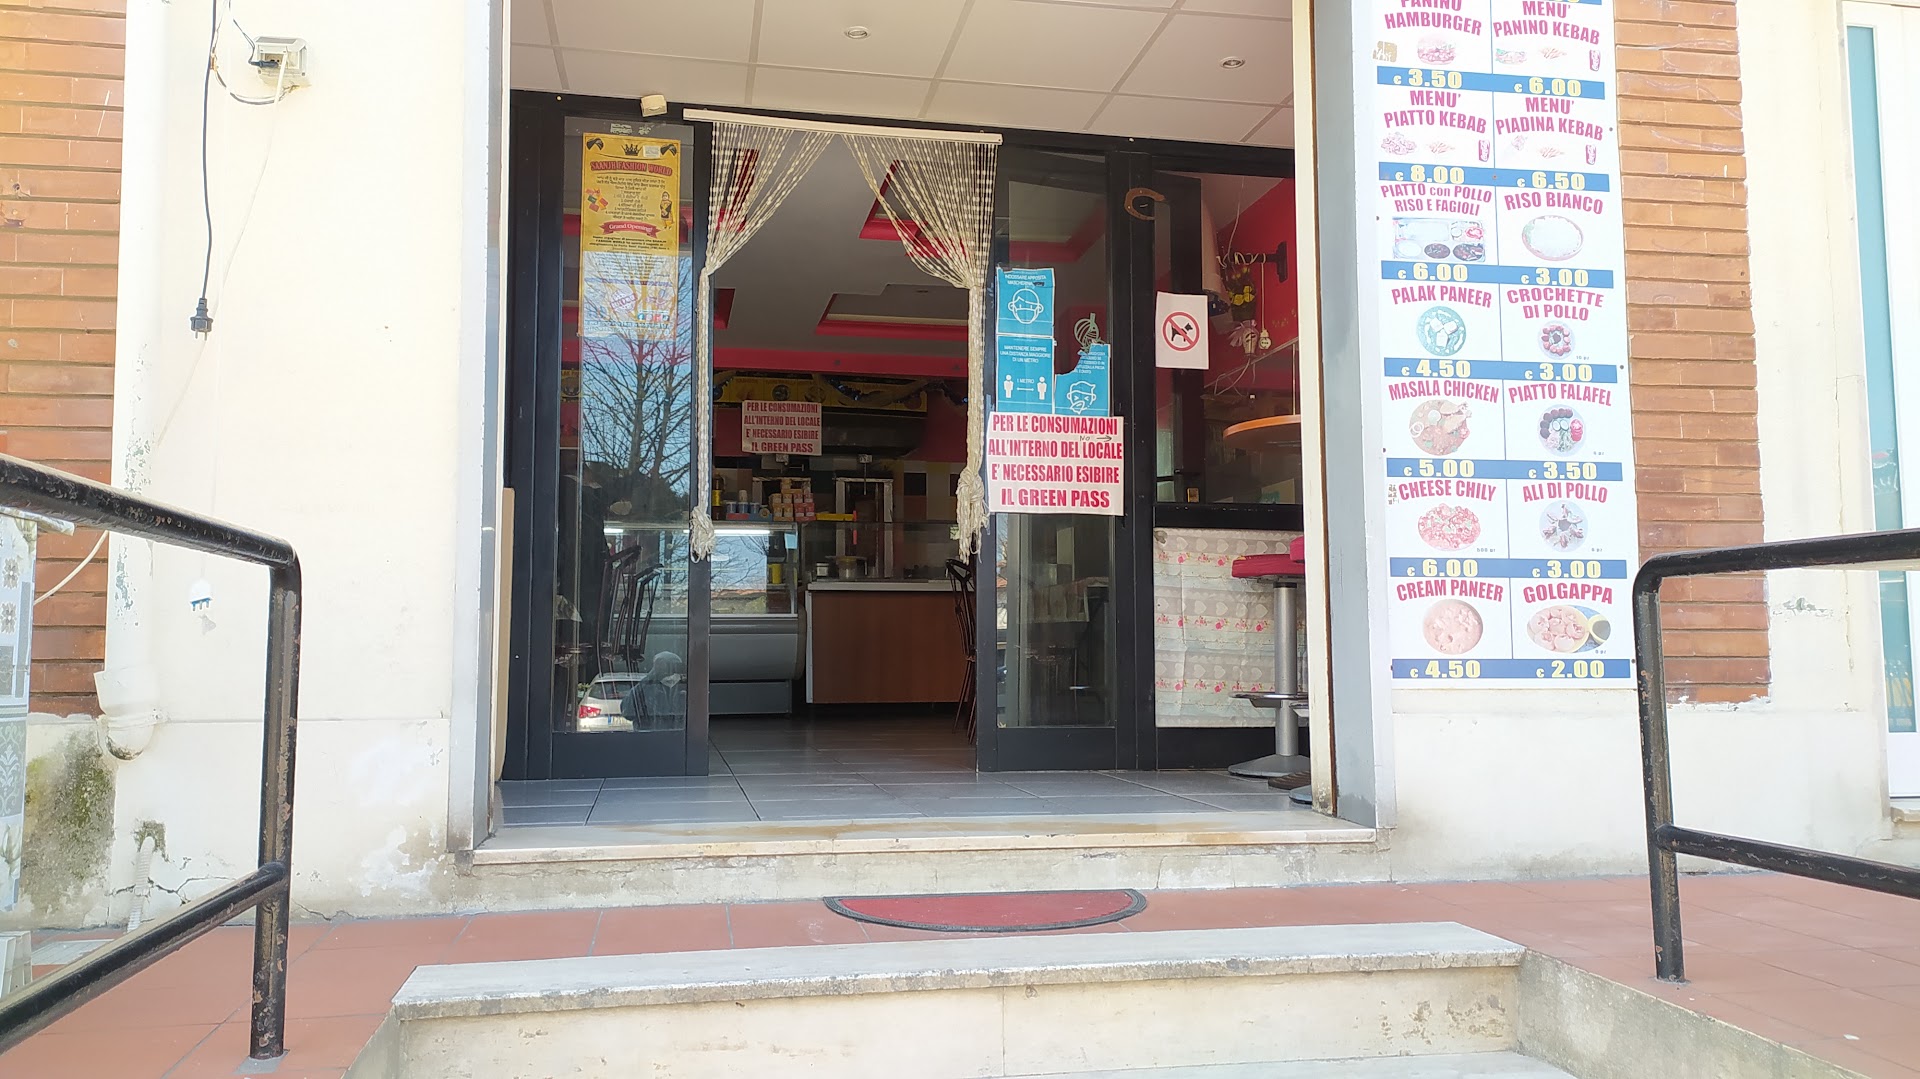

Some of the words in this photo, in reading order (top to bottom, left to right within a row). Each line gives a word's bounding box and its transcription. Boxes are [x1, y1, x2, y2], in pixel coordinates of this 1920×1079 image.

[1522, 1, 1571, 19] MENU'
[1385, 12, 1481, 35] HAMBURGER
[1494, 20, 1548, 36] PANINO
[1553, 22, 1599, 44] KEBAB
[1409, 68, 1462, 88] 3.50
[1529, 77, 1581, 96] 6.00
[1409, 90, 1461, 107] MENU'
[1525, 97, 1574, 115] MENU'
[1384, 110, 1434, 128] PIATTO
[1440, 111, 1486, 133] KEBAB
[1496, 117, 1554, 134] PIADINA
[1559, 118, 1602, 140] KEBAB
[617, 161, 647, 172] FASHION
[648, 164, 672, 176] WORLD
[1411, 165, 1465, 184] 8.00
[1532, 172, 1586, 190] 6.50
[1381, 184, 1426, 197] PIATTO
[1430, 188, 1450, 196] con
[1454, 186, 1491, 202] POLLO
[1395, 199, 1423, 211] RISO
[1427, 200, 1431, 210] E
[1436, 200, 1479, 215] FAGIOLI
[1505, 192, 1541, 210] RISO
[1546, 192, 1602, 214] BIANCO
[1413, 263, 1468, 281] 6.00
[1535, 268, 1589, 286] 3.00
[1392, 286, 1436, 304] PALAK
[1441, 286, 1491, 307] PANEER
[1507, 287, 1605, 308] CROCHETTE
[1524, 305, 1539, 318] DI
[1544, 305, 1588, 320] POLLO
[1416, 360, 1472, 378] 4.50
[1540, 364, 1593, 382] 3.00
[1389, 380, 1440, 400] MASALA
[1444, 380, 1498, 402] CHICKEN
[1509, 384, 1556, 403] PIATTO
[1561, 384, 1612, 406] FALAFEL
[747, 402, 759, 411] PER
[761, 403, 767, 411] LE
[769, 403, 817, 413] CONSUMAZIONI
[744, 415, 783, 425] ALL'INTERNO
[785, 417, 796, 425] DEL
[798, 417, 820, 426] LOCALE
[993, 415, 1014, 431] PER
[1017, 416, 1028, 432] LE
[1031, 415, 1118, 435] CONSUMAZIONI
[753, 429, 792, 438] NECESSARIO
[794, 430, 818, 439] ESIBIRE
[752, 442, 758, 451] IL
[761, 442, 788, 452] GREEN
[791, 443, 813, 453] PASS
[989, 439, 1058, 457] ALL'INTERNO
[1061, 441, 1080, 458] DEL
[1082, 441, 1122, 459] LOCALE
[991, 463, 1000, 482] E'
[1003, 464, 1073, 482] NECESSARIO
[1076, 466, 1120, 484] ESIBIRE
[1419, 460, 1474, 478] 5.00
[1543, 463, 1598, 480] 3.50
[1002, 489, 1014, 505] IL
[1018, 489, 1067, 506] GREEN
[1071, 490, 1110, 508] PASS
[1399, 480, 1451, 500] CHEESE
[1456, 480, 1495, 500] CHILY
[1523, 484, 1543, 502] ALI
[1548, 482, 1562, 498] DI
[1566, 483, 1607, 502] POLLO
[1422, 559, 1479, 577] 6.00
[1547, 561, 1602, 579] 3.00
[1397, 580, 1446, 601] CREAM
[1451, 580, 1503, 601] PANEER
[1524, 583, 1612, 604] GOLGAPPA
[1425, 660, 1482, 678] 4.50
[1551, 660, 1605, 678] 2.00
